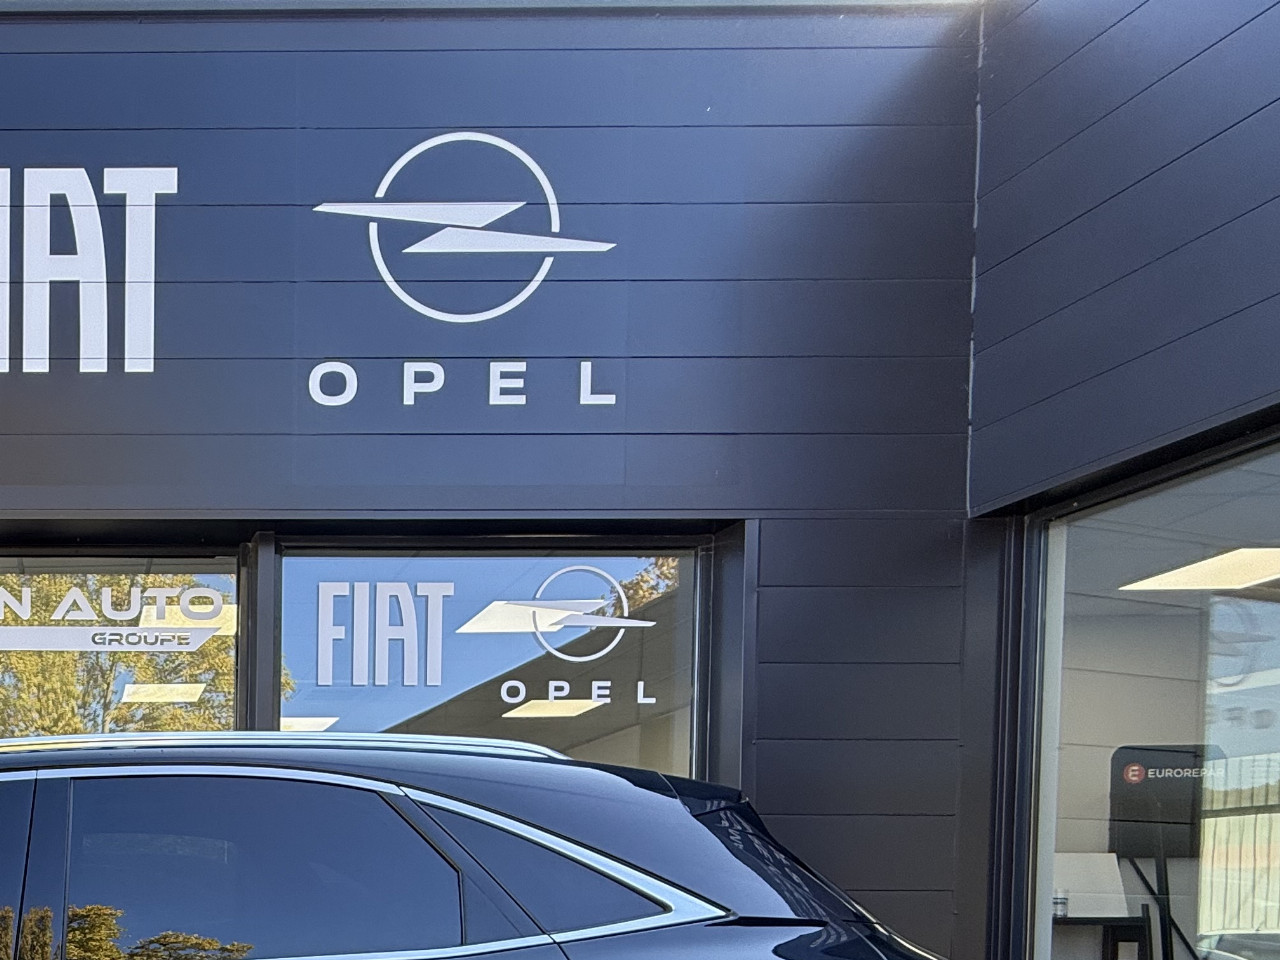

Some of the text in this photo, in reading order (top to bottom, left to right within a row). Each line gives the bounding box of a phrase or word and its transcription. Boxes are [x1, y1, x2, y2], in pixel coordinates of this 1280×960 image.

[308, 361, 616, 405] OPEL
[50, 586, 223, 620] AUTO
[91, 632, 191, 646] GROUPE
[318, 582, 455, 686] FIAT
[500, 680, 657, 704] OPEL
[1147, 768, 1224, 778] EUROREPAR
